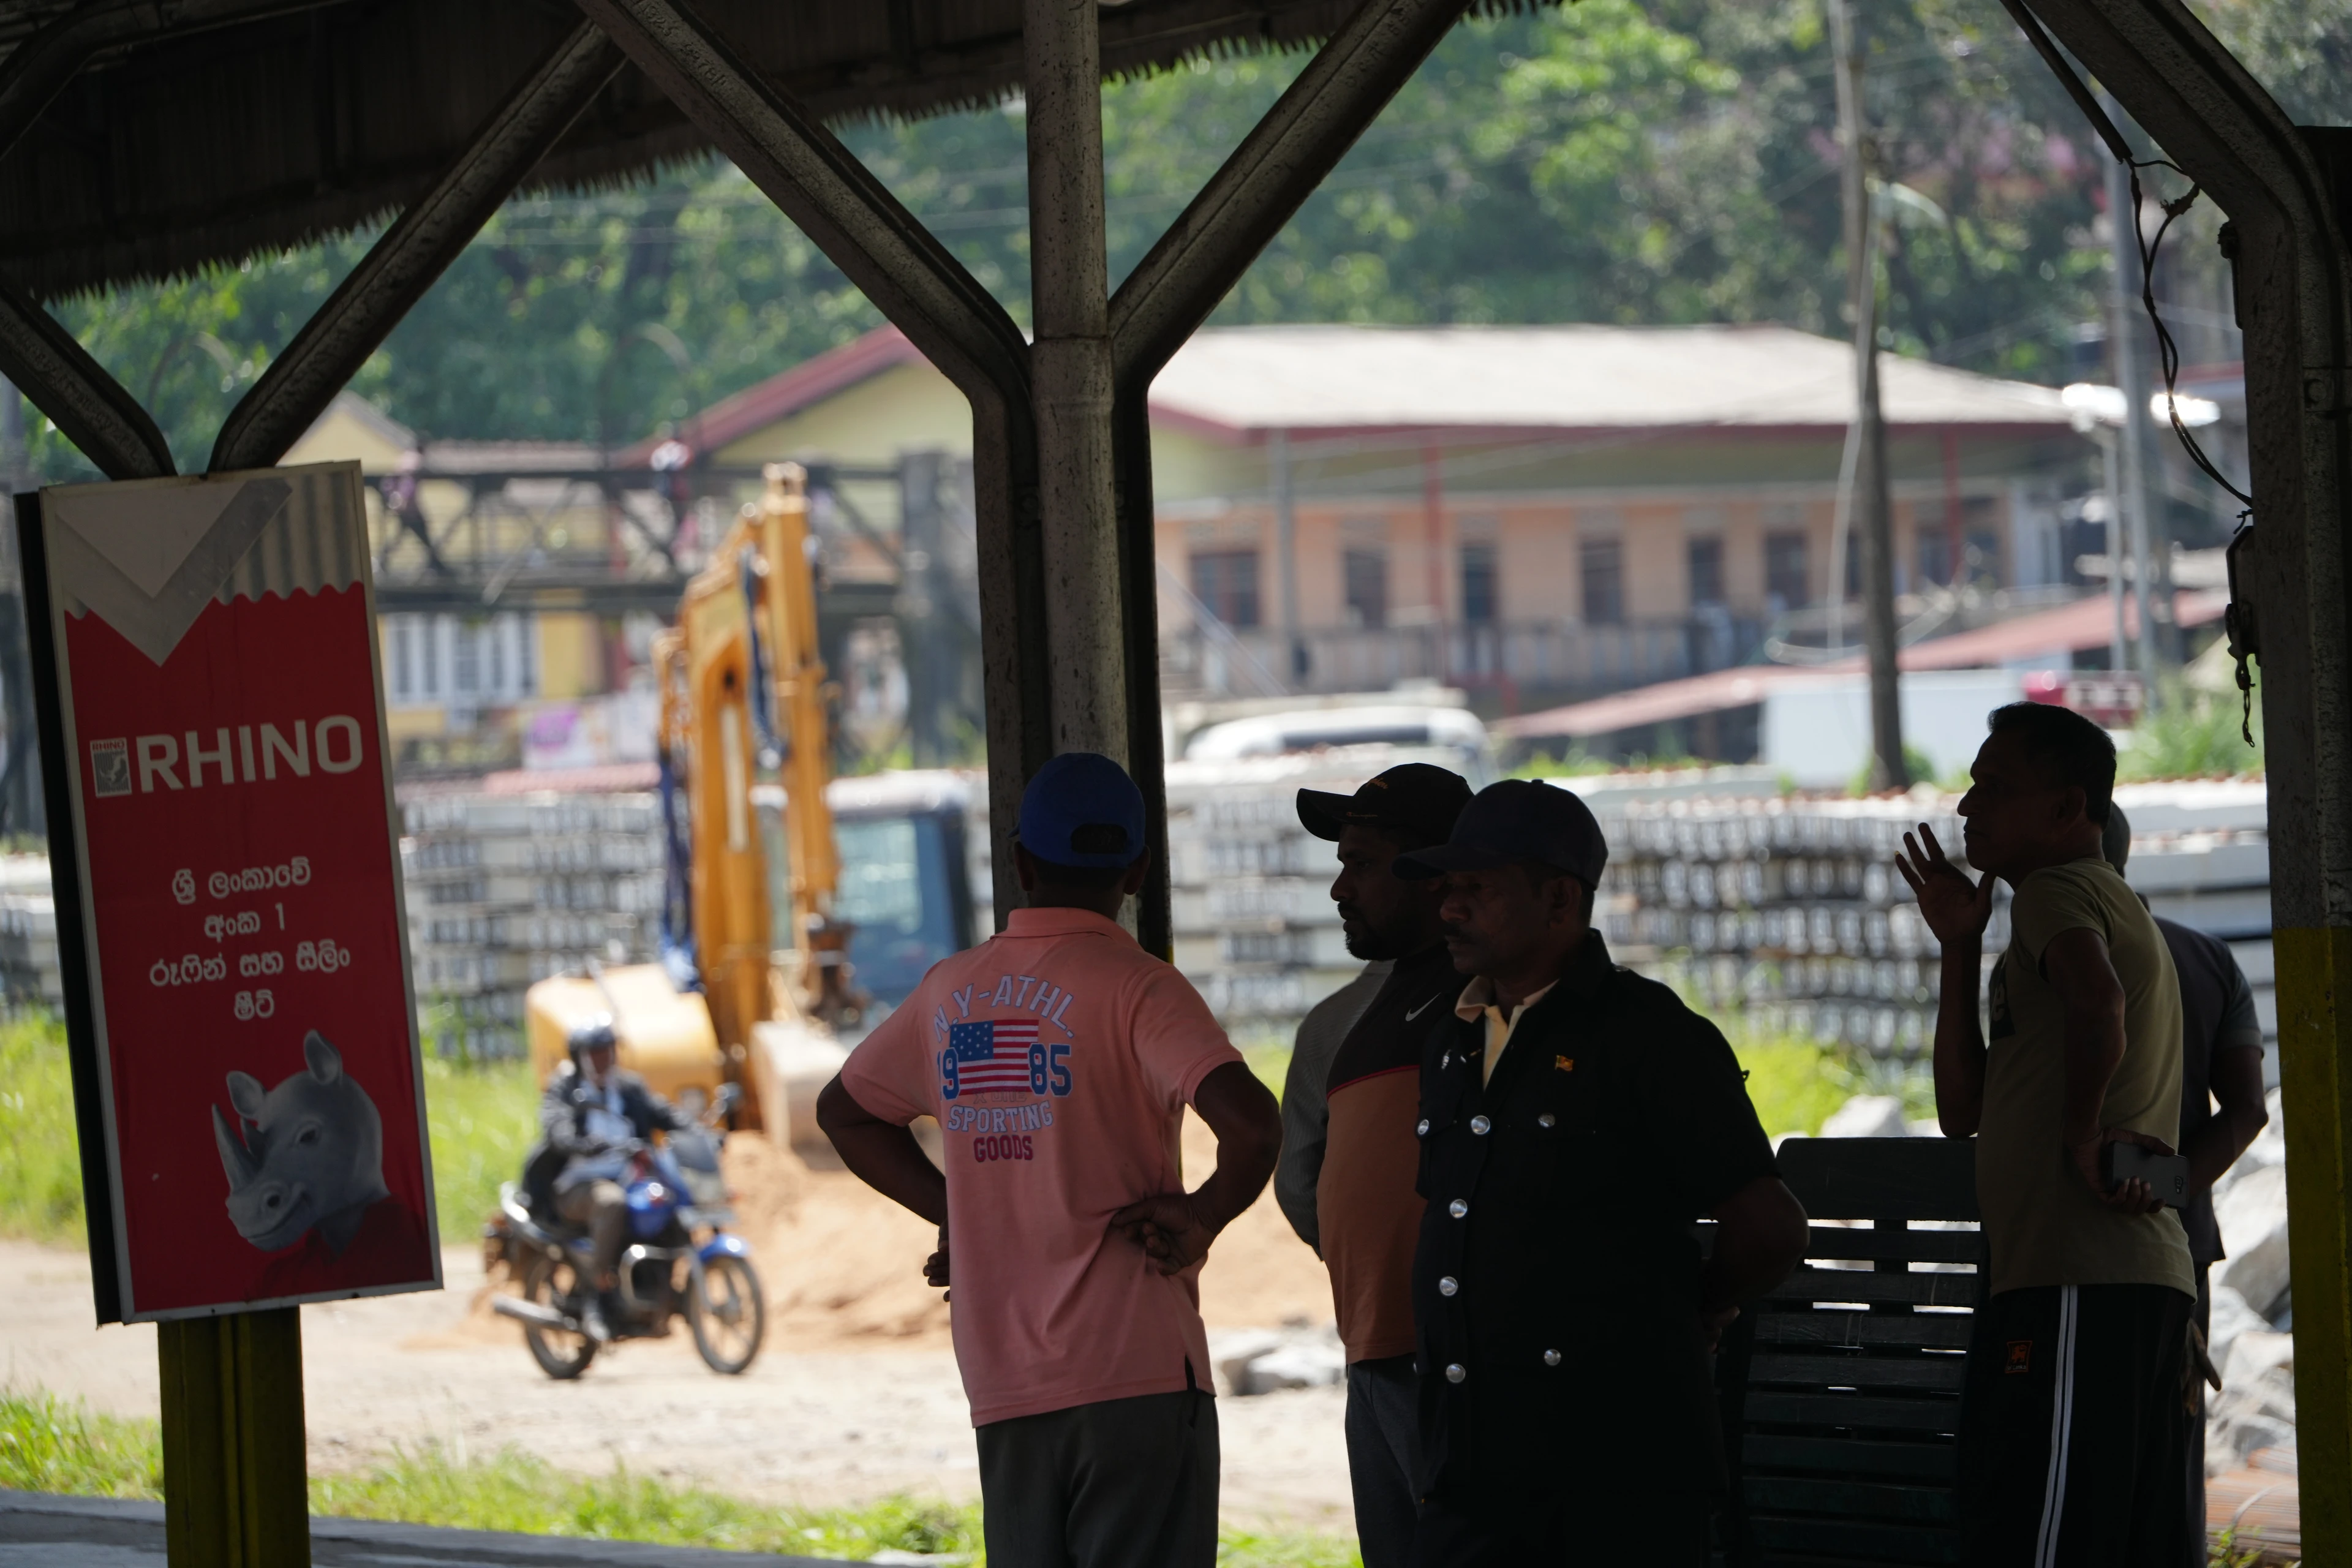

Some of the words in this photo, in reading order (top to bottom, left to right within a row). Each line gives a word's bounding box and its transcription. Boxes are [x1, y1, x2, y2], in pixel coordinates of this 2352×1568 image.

[92, 740, 125, 752] RHINO
[135, 714, 364, 794] RHINO
[208, 856, 311, 899] ලංකාවේ
[204, 911, 261, 943] අංක
[275, 902, 285, 930] 1
[239, 951, 284, 978] සහ
[948, 1100, 1054, 1133] SPORTING
[973, 1134, 1034, 1163] GOODS
